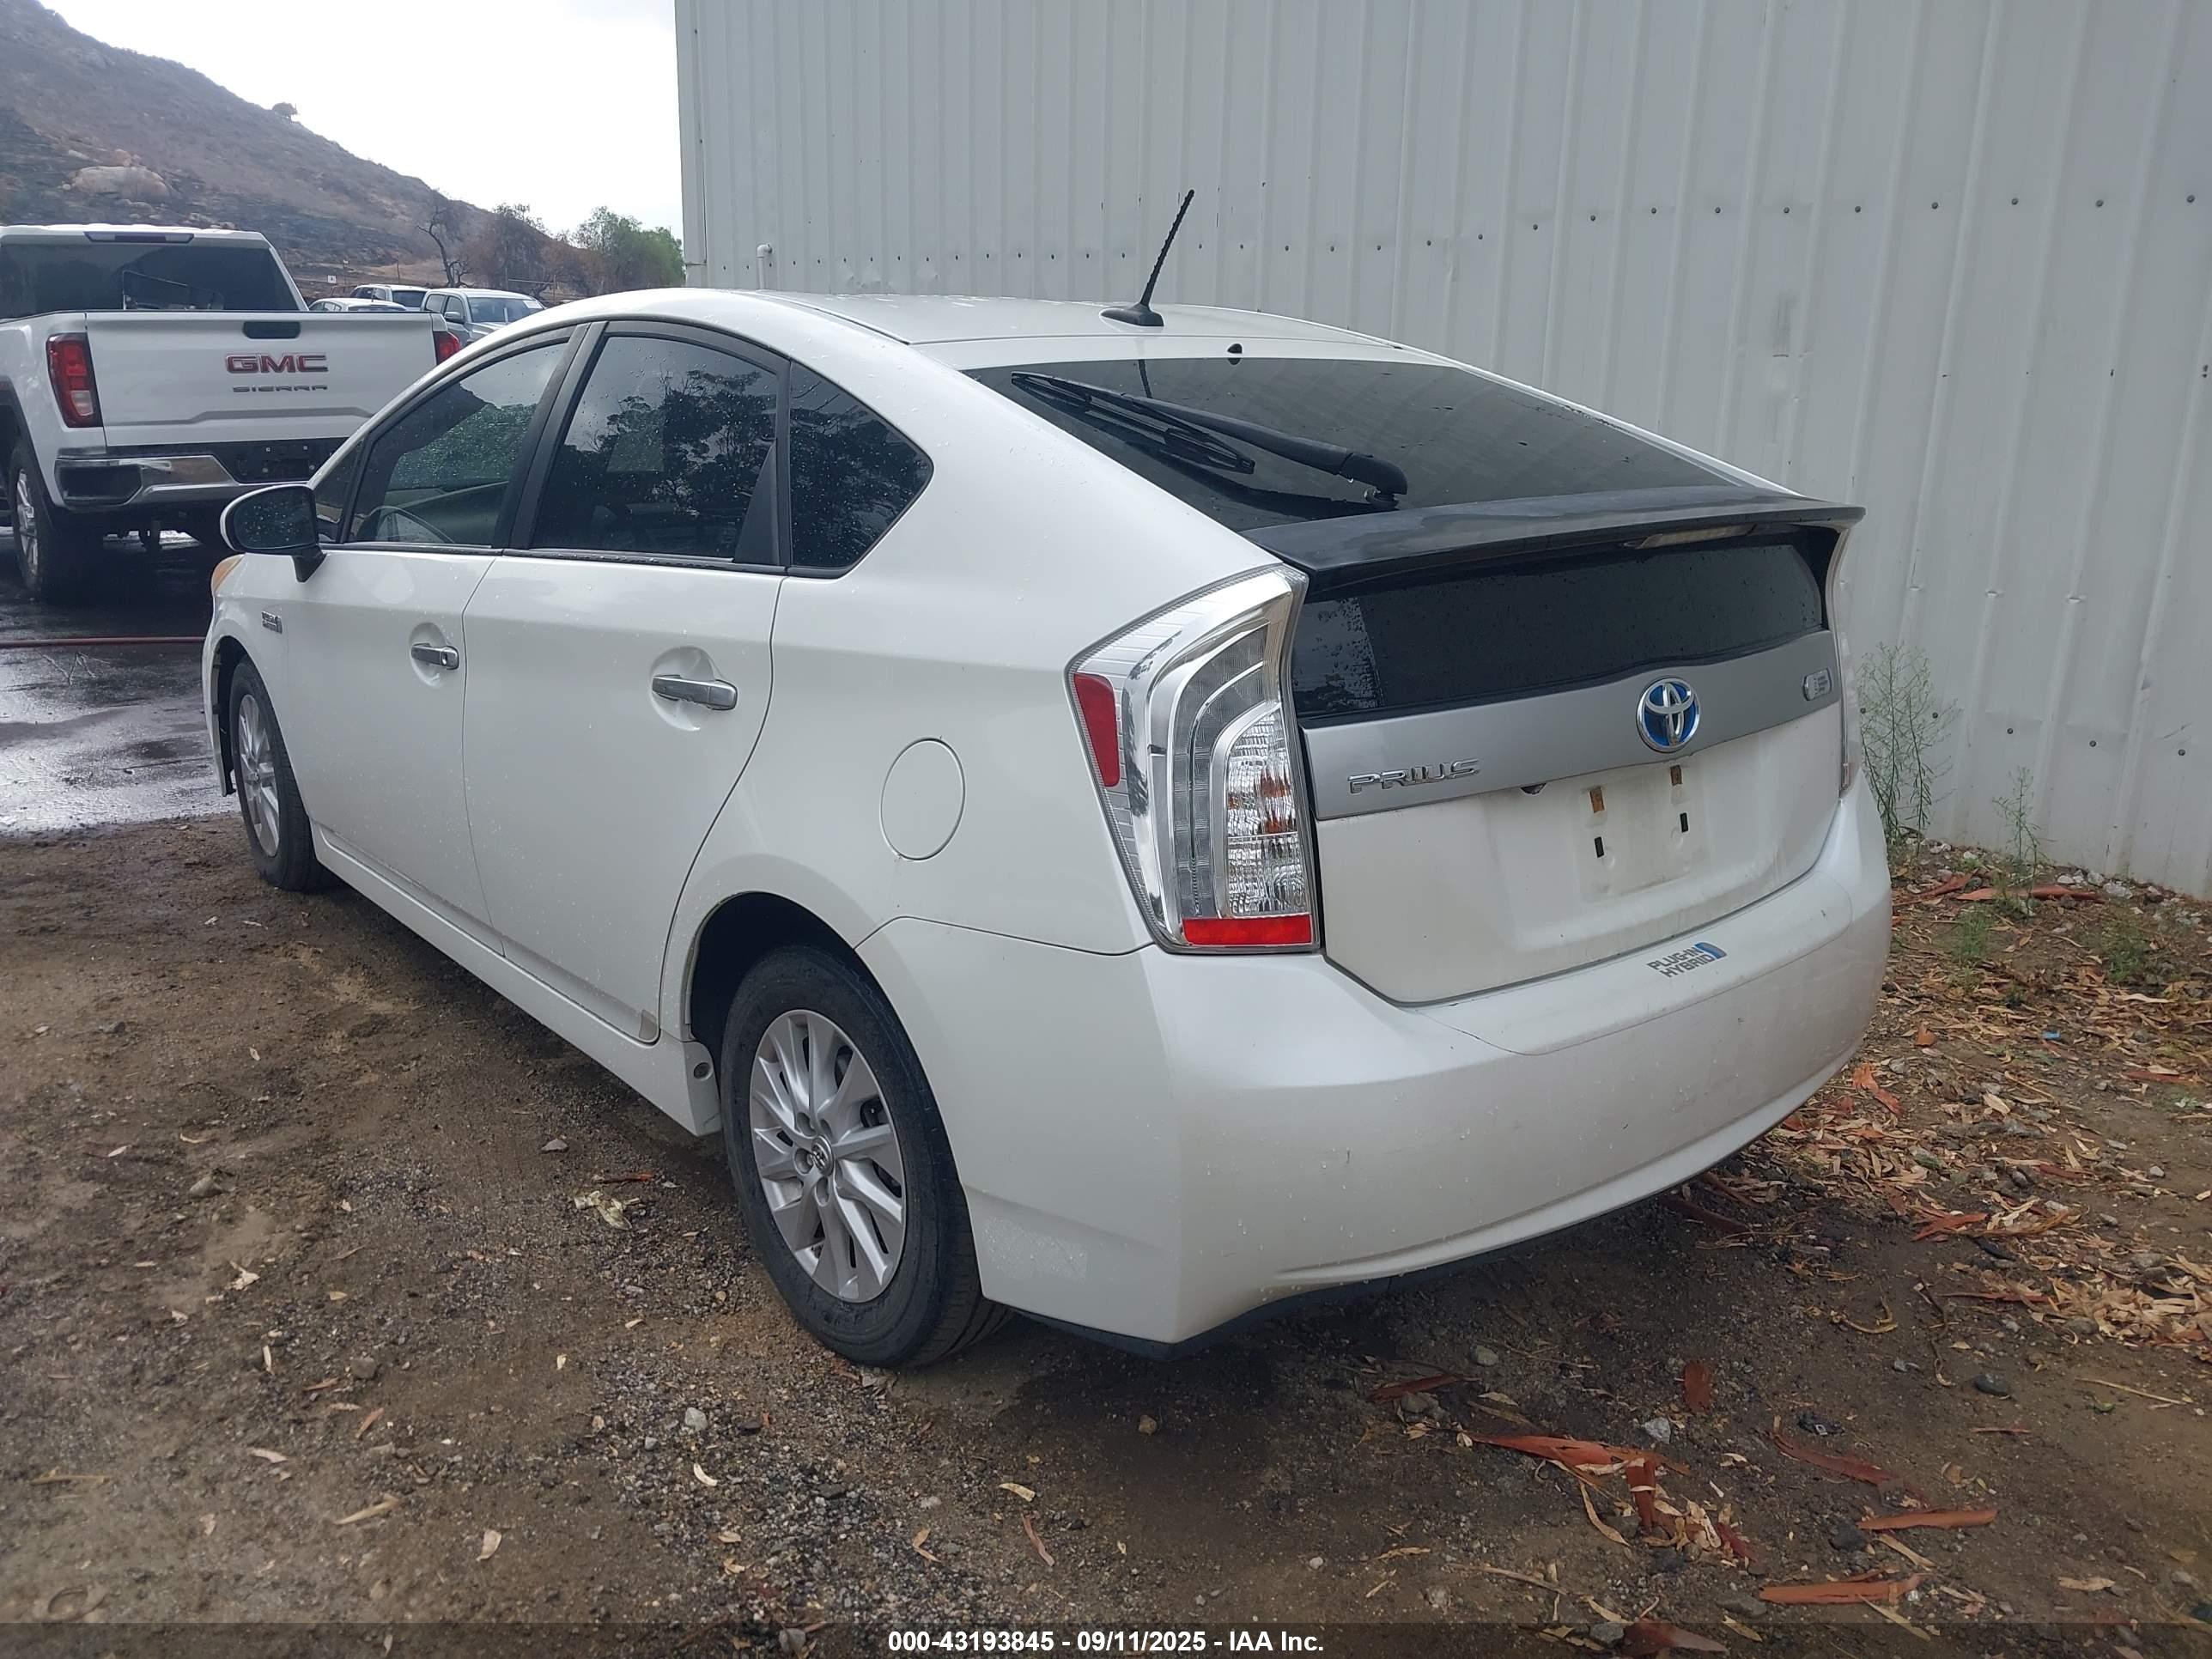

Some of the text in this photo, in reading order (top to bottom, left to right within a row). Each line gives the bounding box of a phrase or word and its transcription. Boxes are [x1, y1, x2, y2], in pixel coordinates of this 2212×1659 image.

[226, 353, 329, 374] GMC
[1347, 758, 1480, 796] PRIUS
[1659, 954, 1716, 978] HYBRID
